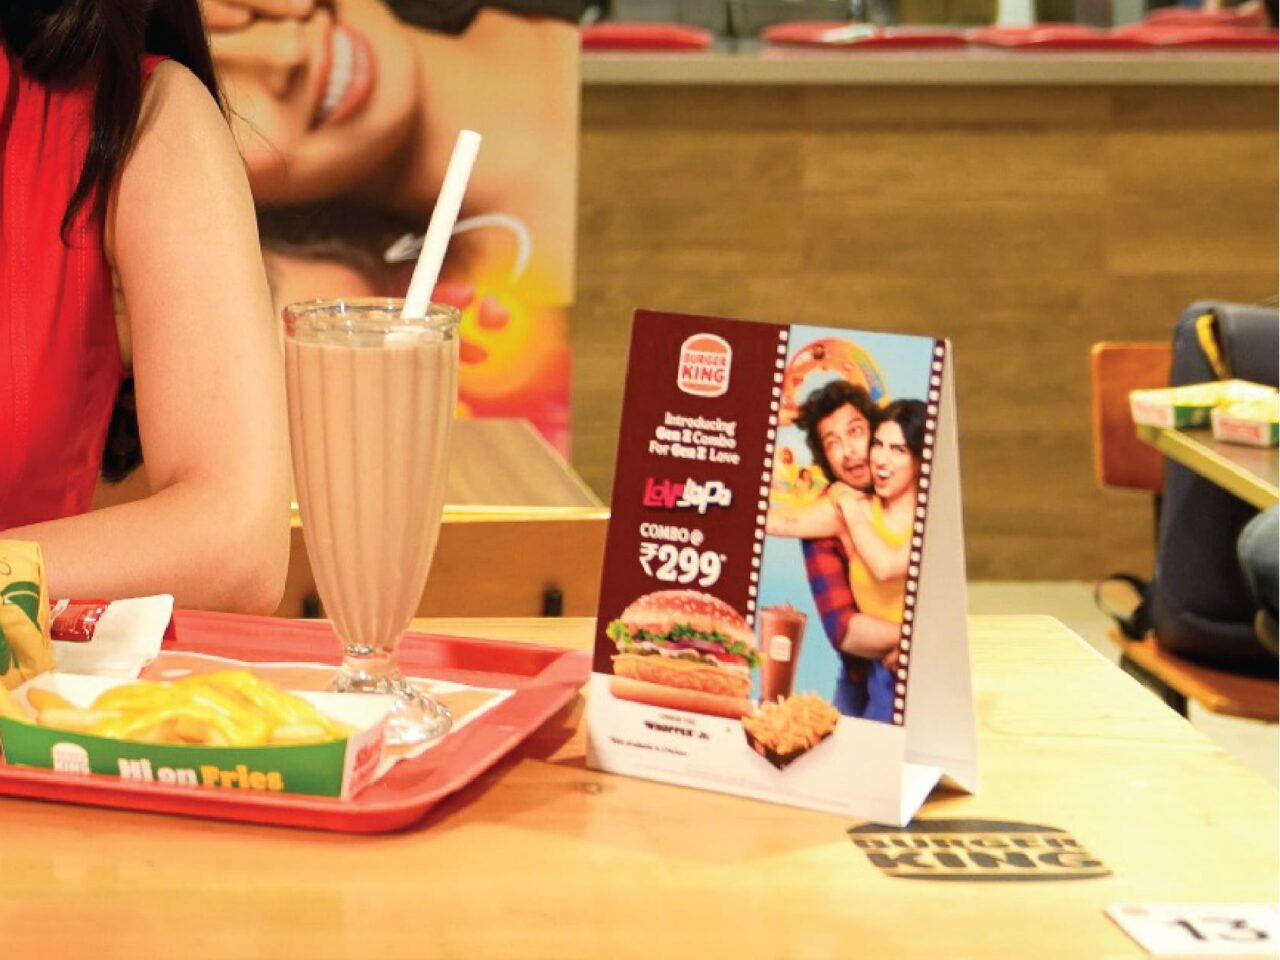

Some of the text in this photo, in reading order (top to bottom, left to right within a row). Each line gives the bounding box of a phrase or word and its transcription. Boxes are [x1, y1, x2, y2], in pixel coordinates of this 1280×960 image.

[683, 352, 728, 367] BURGER
[681, 365, 726, 383] KING
[665, 411, 737, 436] Introducing
[693, 430, 737, 448] Combo
[649, 440, 670, 455] For
[709, 448, 740, 464] Love
[639, 522, 689, 543] COMBO
[117, 757, 154, 783] Hi
[157, 767, 198, 787] on
[200, 764, 285, 792] Fries
[855, 838, 1081, 850] BURGER
[867, 852, 1103, 869] KING
